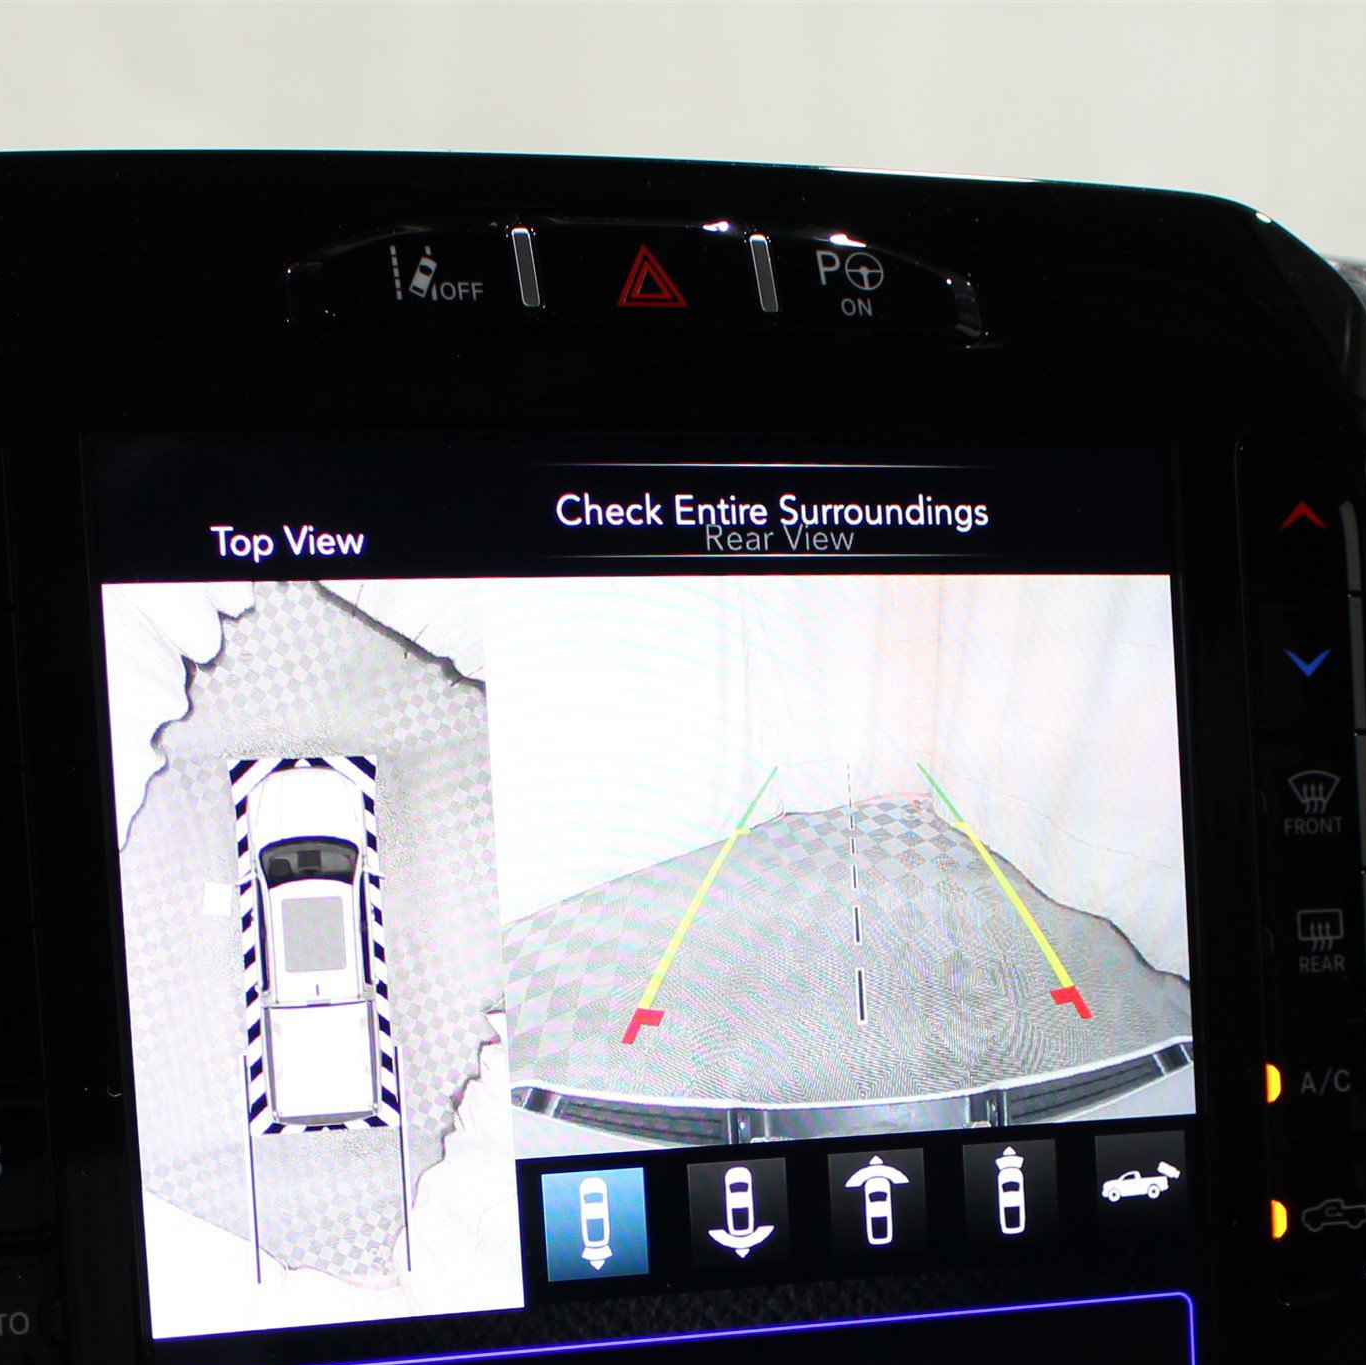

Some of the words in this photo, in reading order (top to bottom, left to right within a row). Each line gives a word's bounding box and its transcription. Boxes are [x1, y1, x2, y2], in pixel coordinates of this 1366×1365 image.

[815, 249, 841, 286] P
[439, 281, 484, 301] OFF
[840, 297, 873, 317] ON
[555, 491, 664, 527] Check
[674, 494, 770, 527] Entire
[778, 494, 990, 532] Surroundings
[209, 524, 277, 564] Top
[282, 524, 367, 557] View
[705, 523, 775, 553] Rear
[781, 522, 856, 553] View
[1283, 815, 1343, 835] FRONT
[1298, 954, 1346, 974] REAR
[1300, 1068, 1351, 1096] A/C
